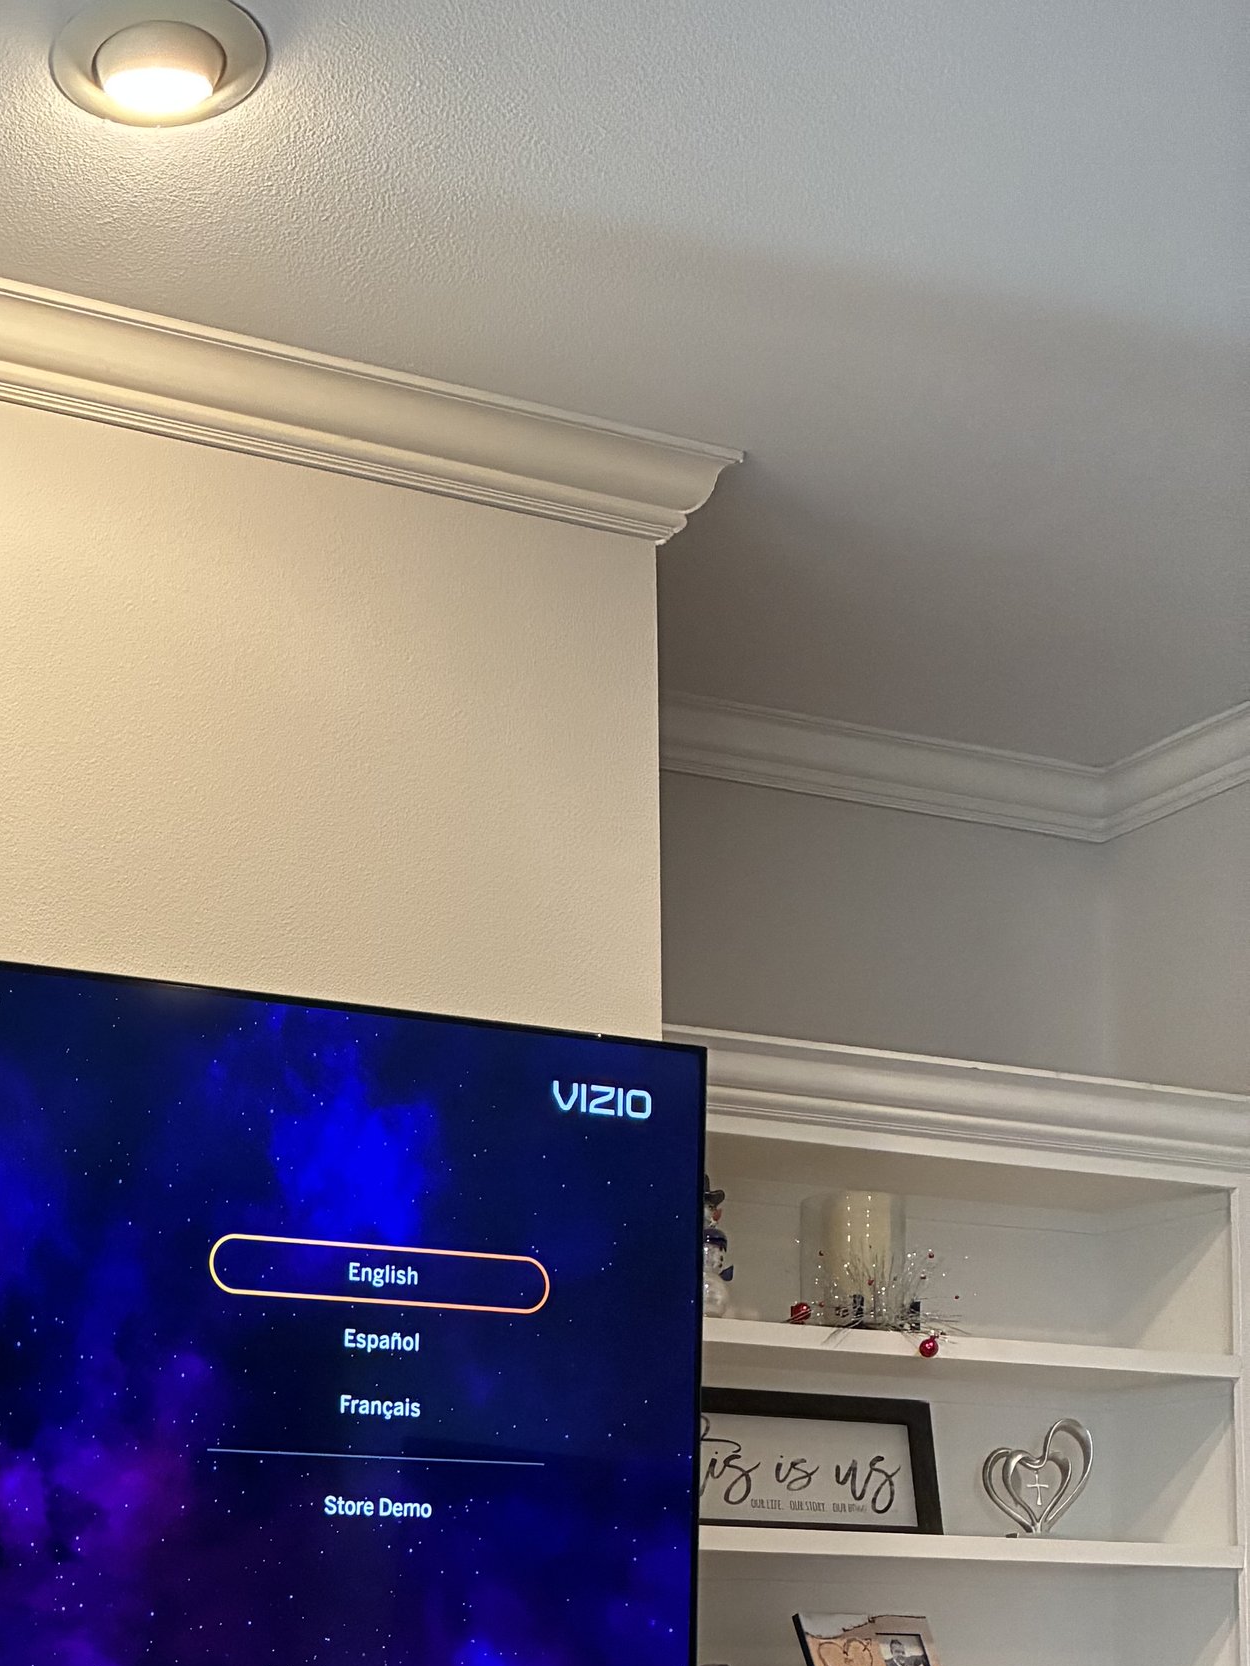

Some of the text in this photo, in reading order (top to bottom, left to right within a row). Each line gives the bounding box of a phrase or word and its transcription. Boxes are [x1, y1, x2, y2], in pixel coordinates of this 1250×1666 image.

[552, 1080, 652, 1120] VIZIO
[348, 1261, 419, 1288] English
[344, 1328, 420, 1353] Español
[340, 1394, 421, 1420] Français
[775, 1455, 820, 1491] is
[835, 1455, 901, 1514] us
[323, 1494, 433, 1519] Store Demo
[789, 1500, 804, 1511] OUR
